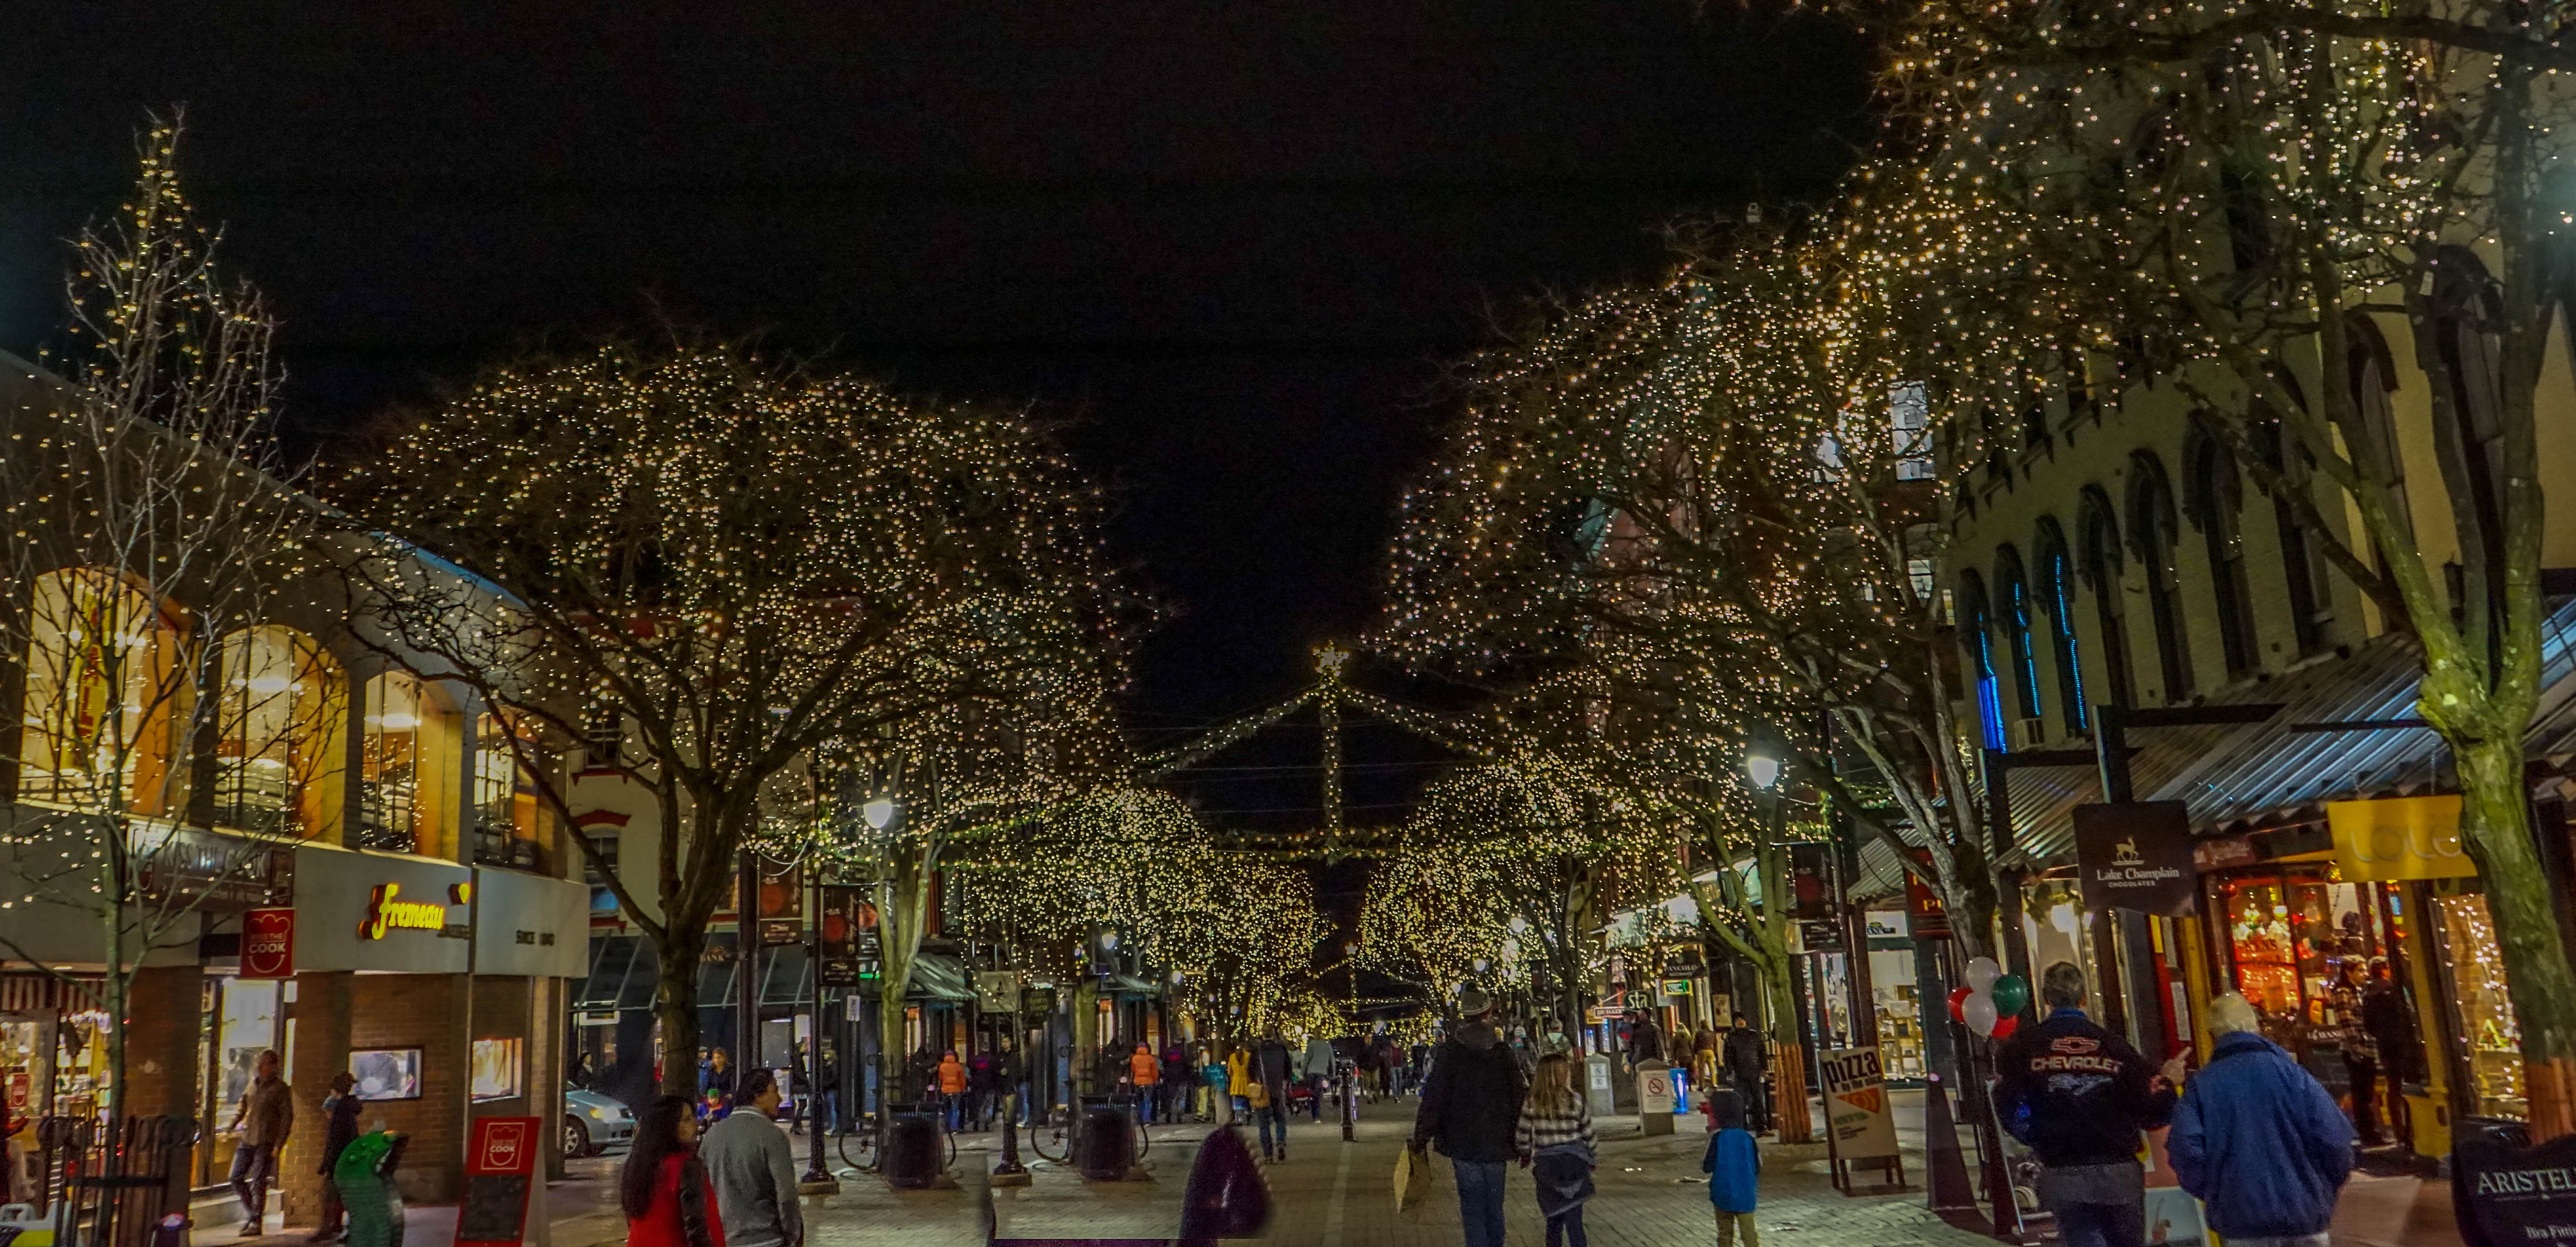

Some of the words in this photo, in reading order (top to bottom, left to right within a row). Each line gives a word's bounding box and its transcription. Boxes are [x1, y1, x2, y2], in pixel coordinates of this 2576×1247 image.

[2096, 869, 2123, 881] Lake
[2125, 867, 2180, 880] Champlain
[2108, 880, 2156, 888] CHOCOLATES
[249, 942, 286, 954] COOK
[1628, 991, 1648, 1009] sta
[1821, 1051, 1883, 1093] pizza
[2030, 1055, 2124, 1073] CHEVROLET
[2477, 1168, 2576, 1195] ARISTEL
